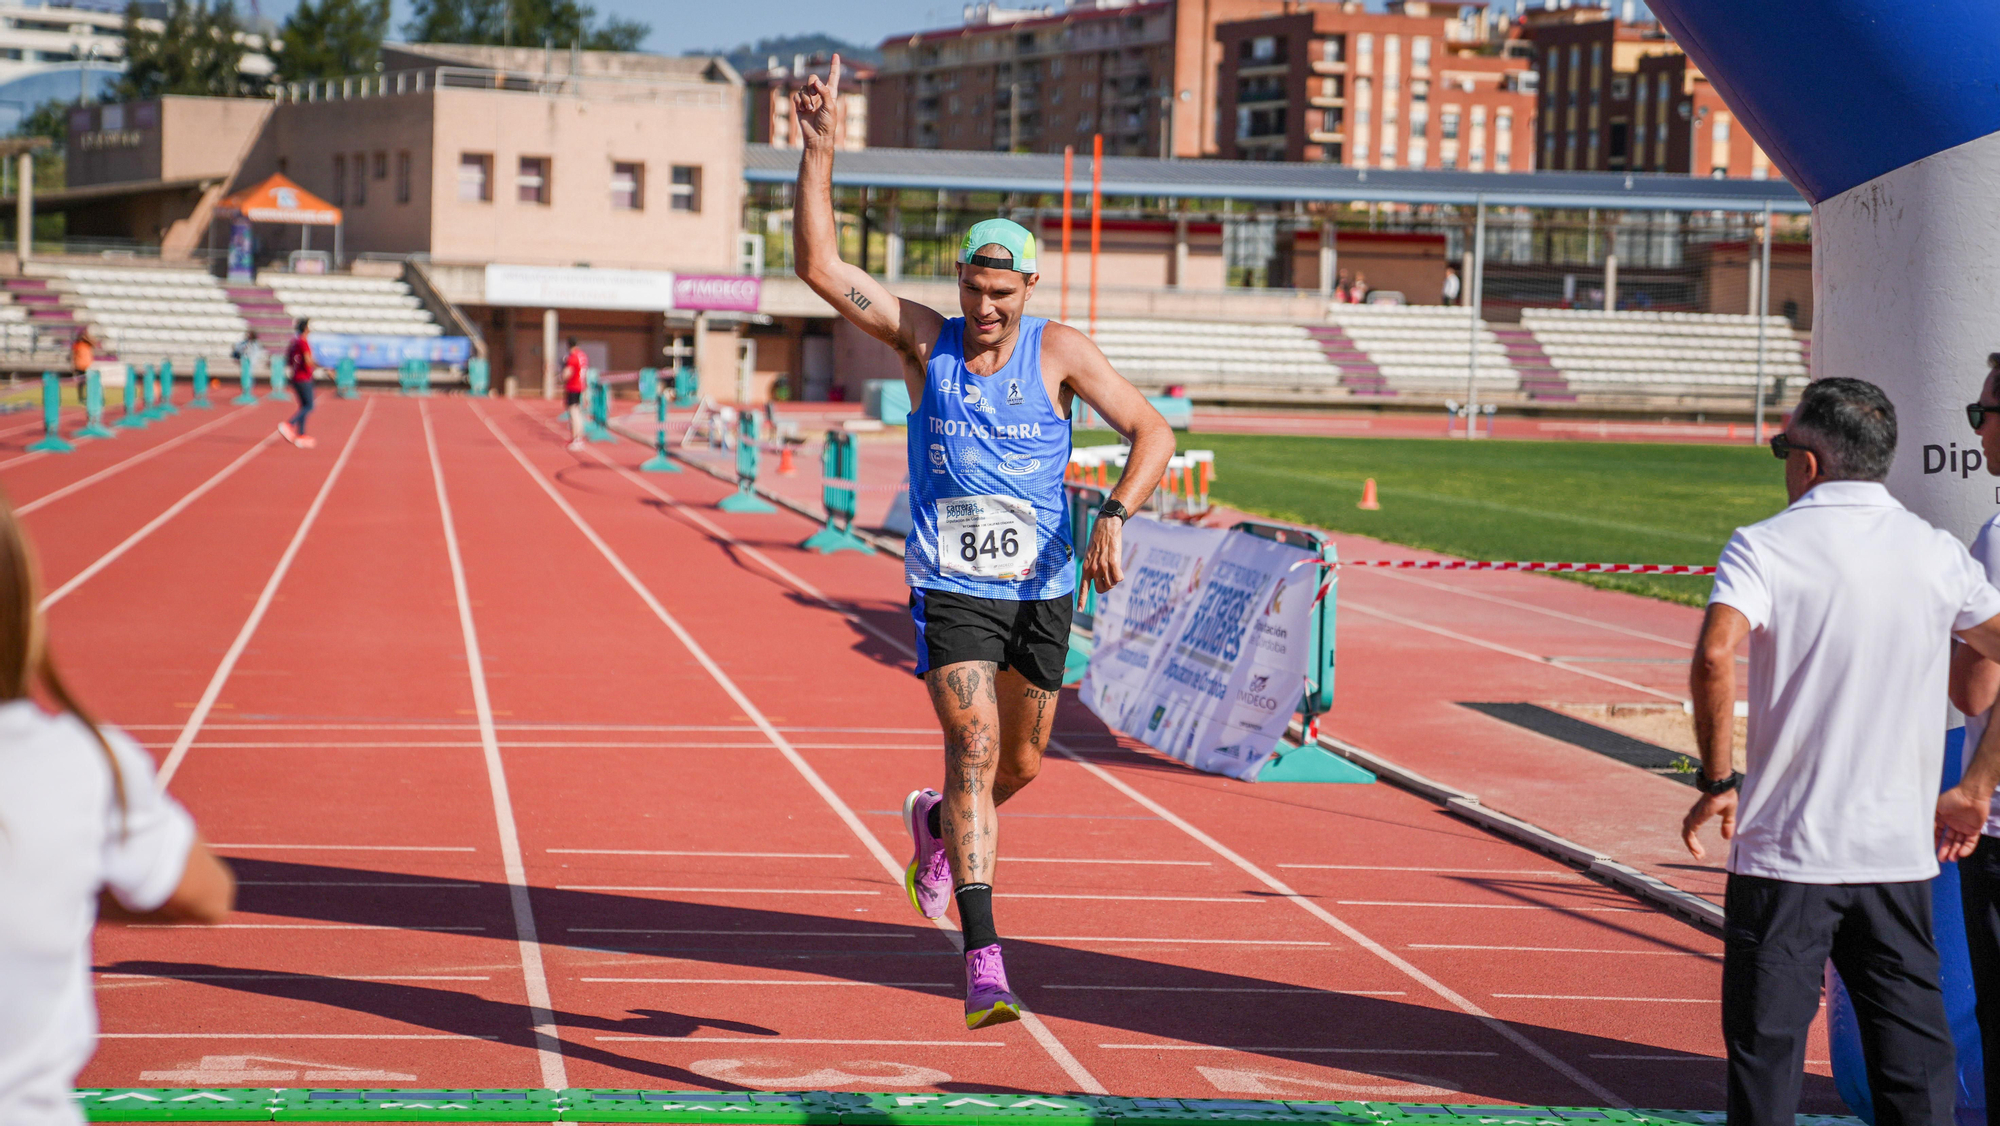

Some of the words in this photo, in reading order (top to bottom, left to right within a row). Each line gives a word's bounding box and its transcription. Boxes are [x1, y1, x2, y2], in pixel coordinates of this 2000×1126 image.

[844, 287, 872, 311] XIII
[975, 403, 996, 414] Smith
[929, 416, 1041, 439] TROTASIERRA
[946, 503, 978, 511] carreras
[946, 508, 984, 518] populares
[960, 528, 1019, 562] 846
[1199, 580, 1251, 624] carreras
[1236, 689, 1277, 711] IMDECO
